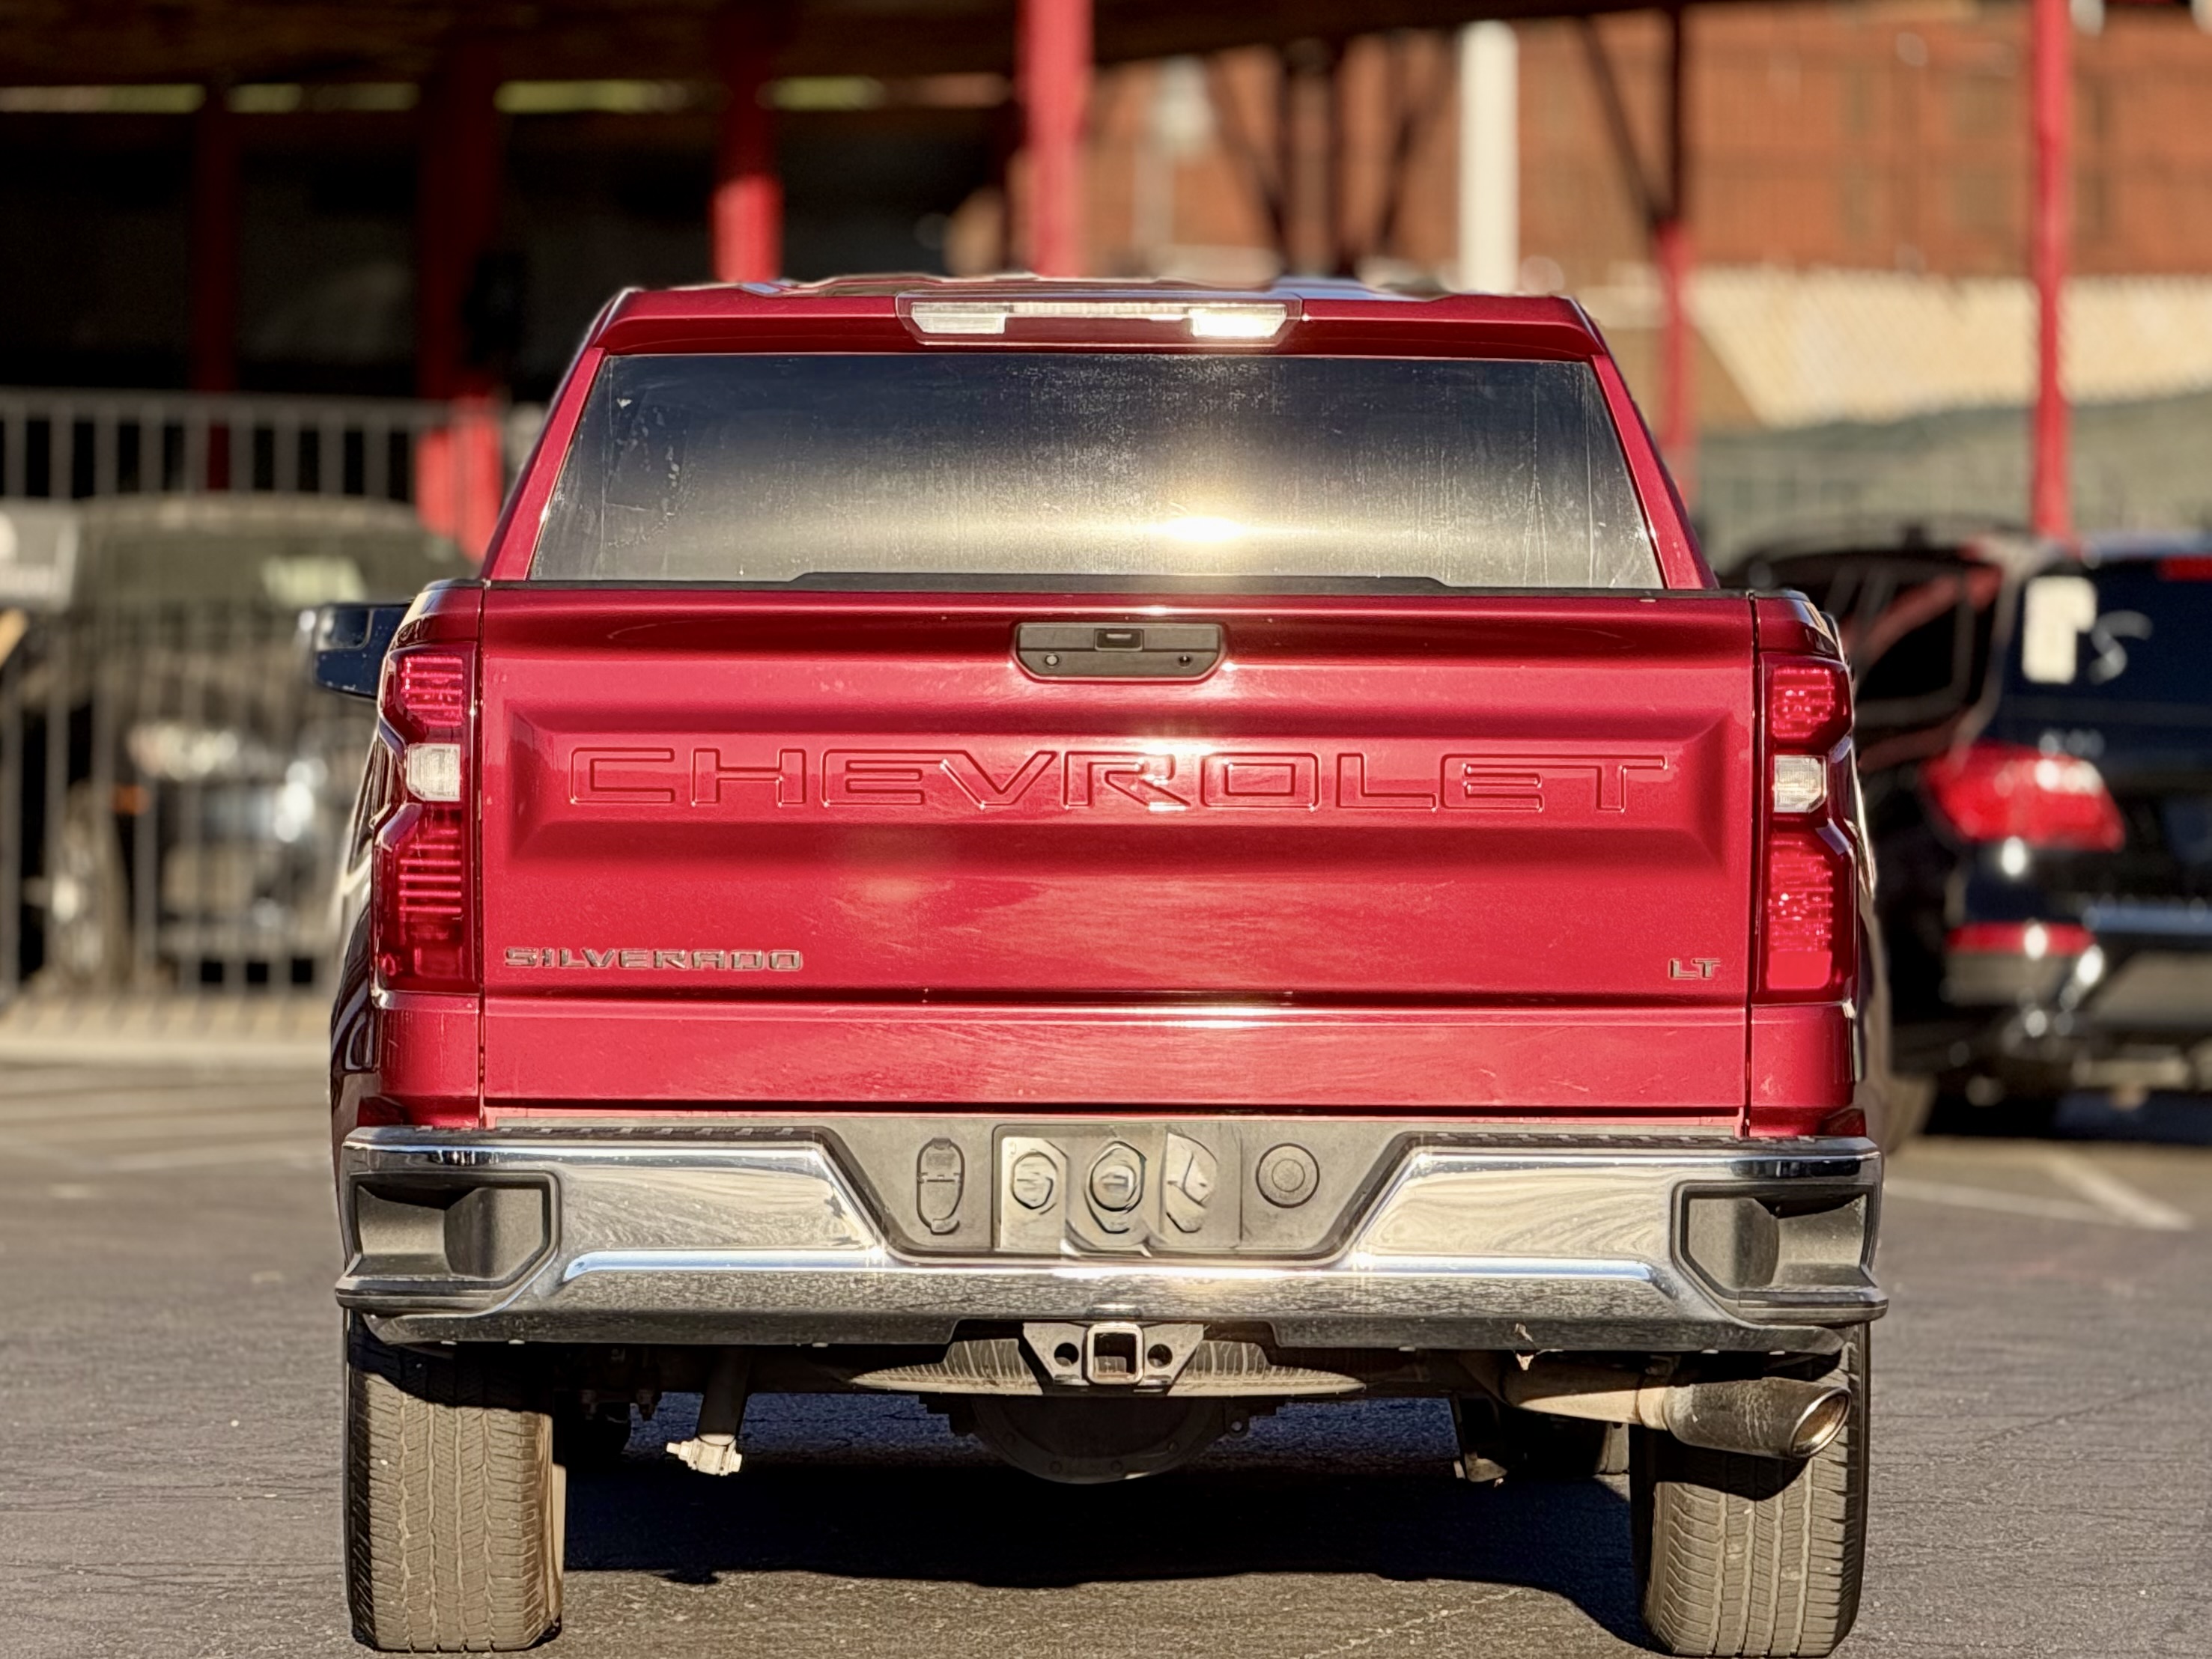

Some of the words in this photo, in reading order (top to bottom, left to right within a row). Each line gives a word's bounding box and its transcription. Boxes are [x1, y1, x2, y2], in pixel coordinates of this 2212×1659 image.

[570, 747, 1668, 812] CHEVROLET
[505, 948, 802, 970] SILVERADO
[1669, 958, 1721, 979] LT
